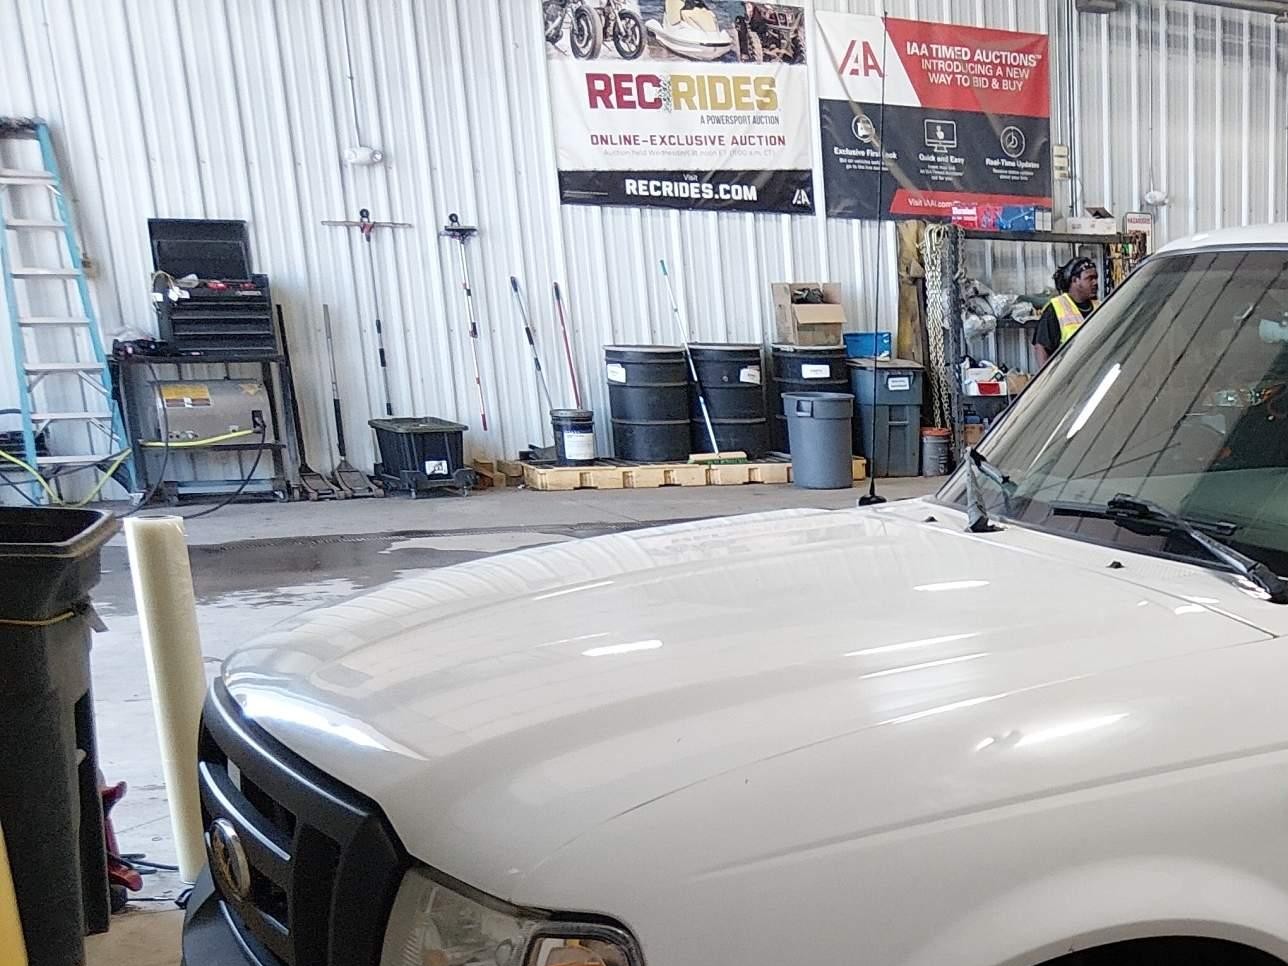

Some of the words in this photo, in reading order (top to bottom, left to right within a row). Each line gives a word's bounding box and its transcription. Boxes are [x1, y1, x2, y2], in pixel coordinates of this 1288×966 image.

[906, 41, 929, 57] IAA
[929, 44, 971, 60] TIMED
[921, 59, 993, 76] INTRODUCING
[996, 66, 1003, 76] A
[1005, 67, 1030, 78] NEW
[928, 72, 953, 86] WAY
[955, 75, 970, 87] TO
[972, 76, 989, 89] BID
[991, 78, 1000, 89] &
[1002, 79, 1024, 92] BUY
[700, 115, 706, 124] A
[706, 115, 752, 125] POWERSPORT
[752, 115, 780, 125] AUCTION
[590, 134, 725, 146] ONLINE-EXCLUSIVE
[731, 135, 787, 146] AUCTION
[833, 146, 866, 156] Exclusive
[918, 153, 936, 161] Quick
[936, 155, 949, 163] and
[950, 156, 965, 165] Easy
[985, 158, 1016, 167] Real-Time
[1016, 159, 1040, 169] Updates
[683, 173, 698, 182] Visit
[625, 179, 758, 201] RECRIDES.COM
